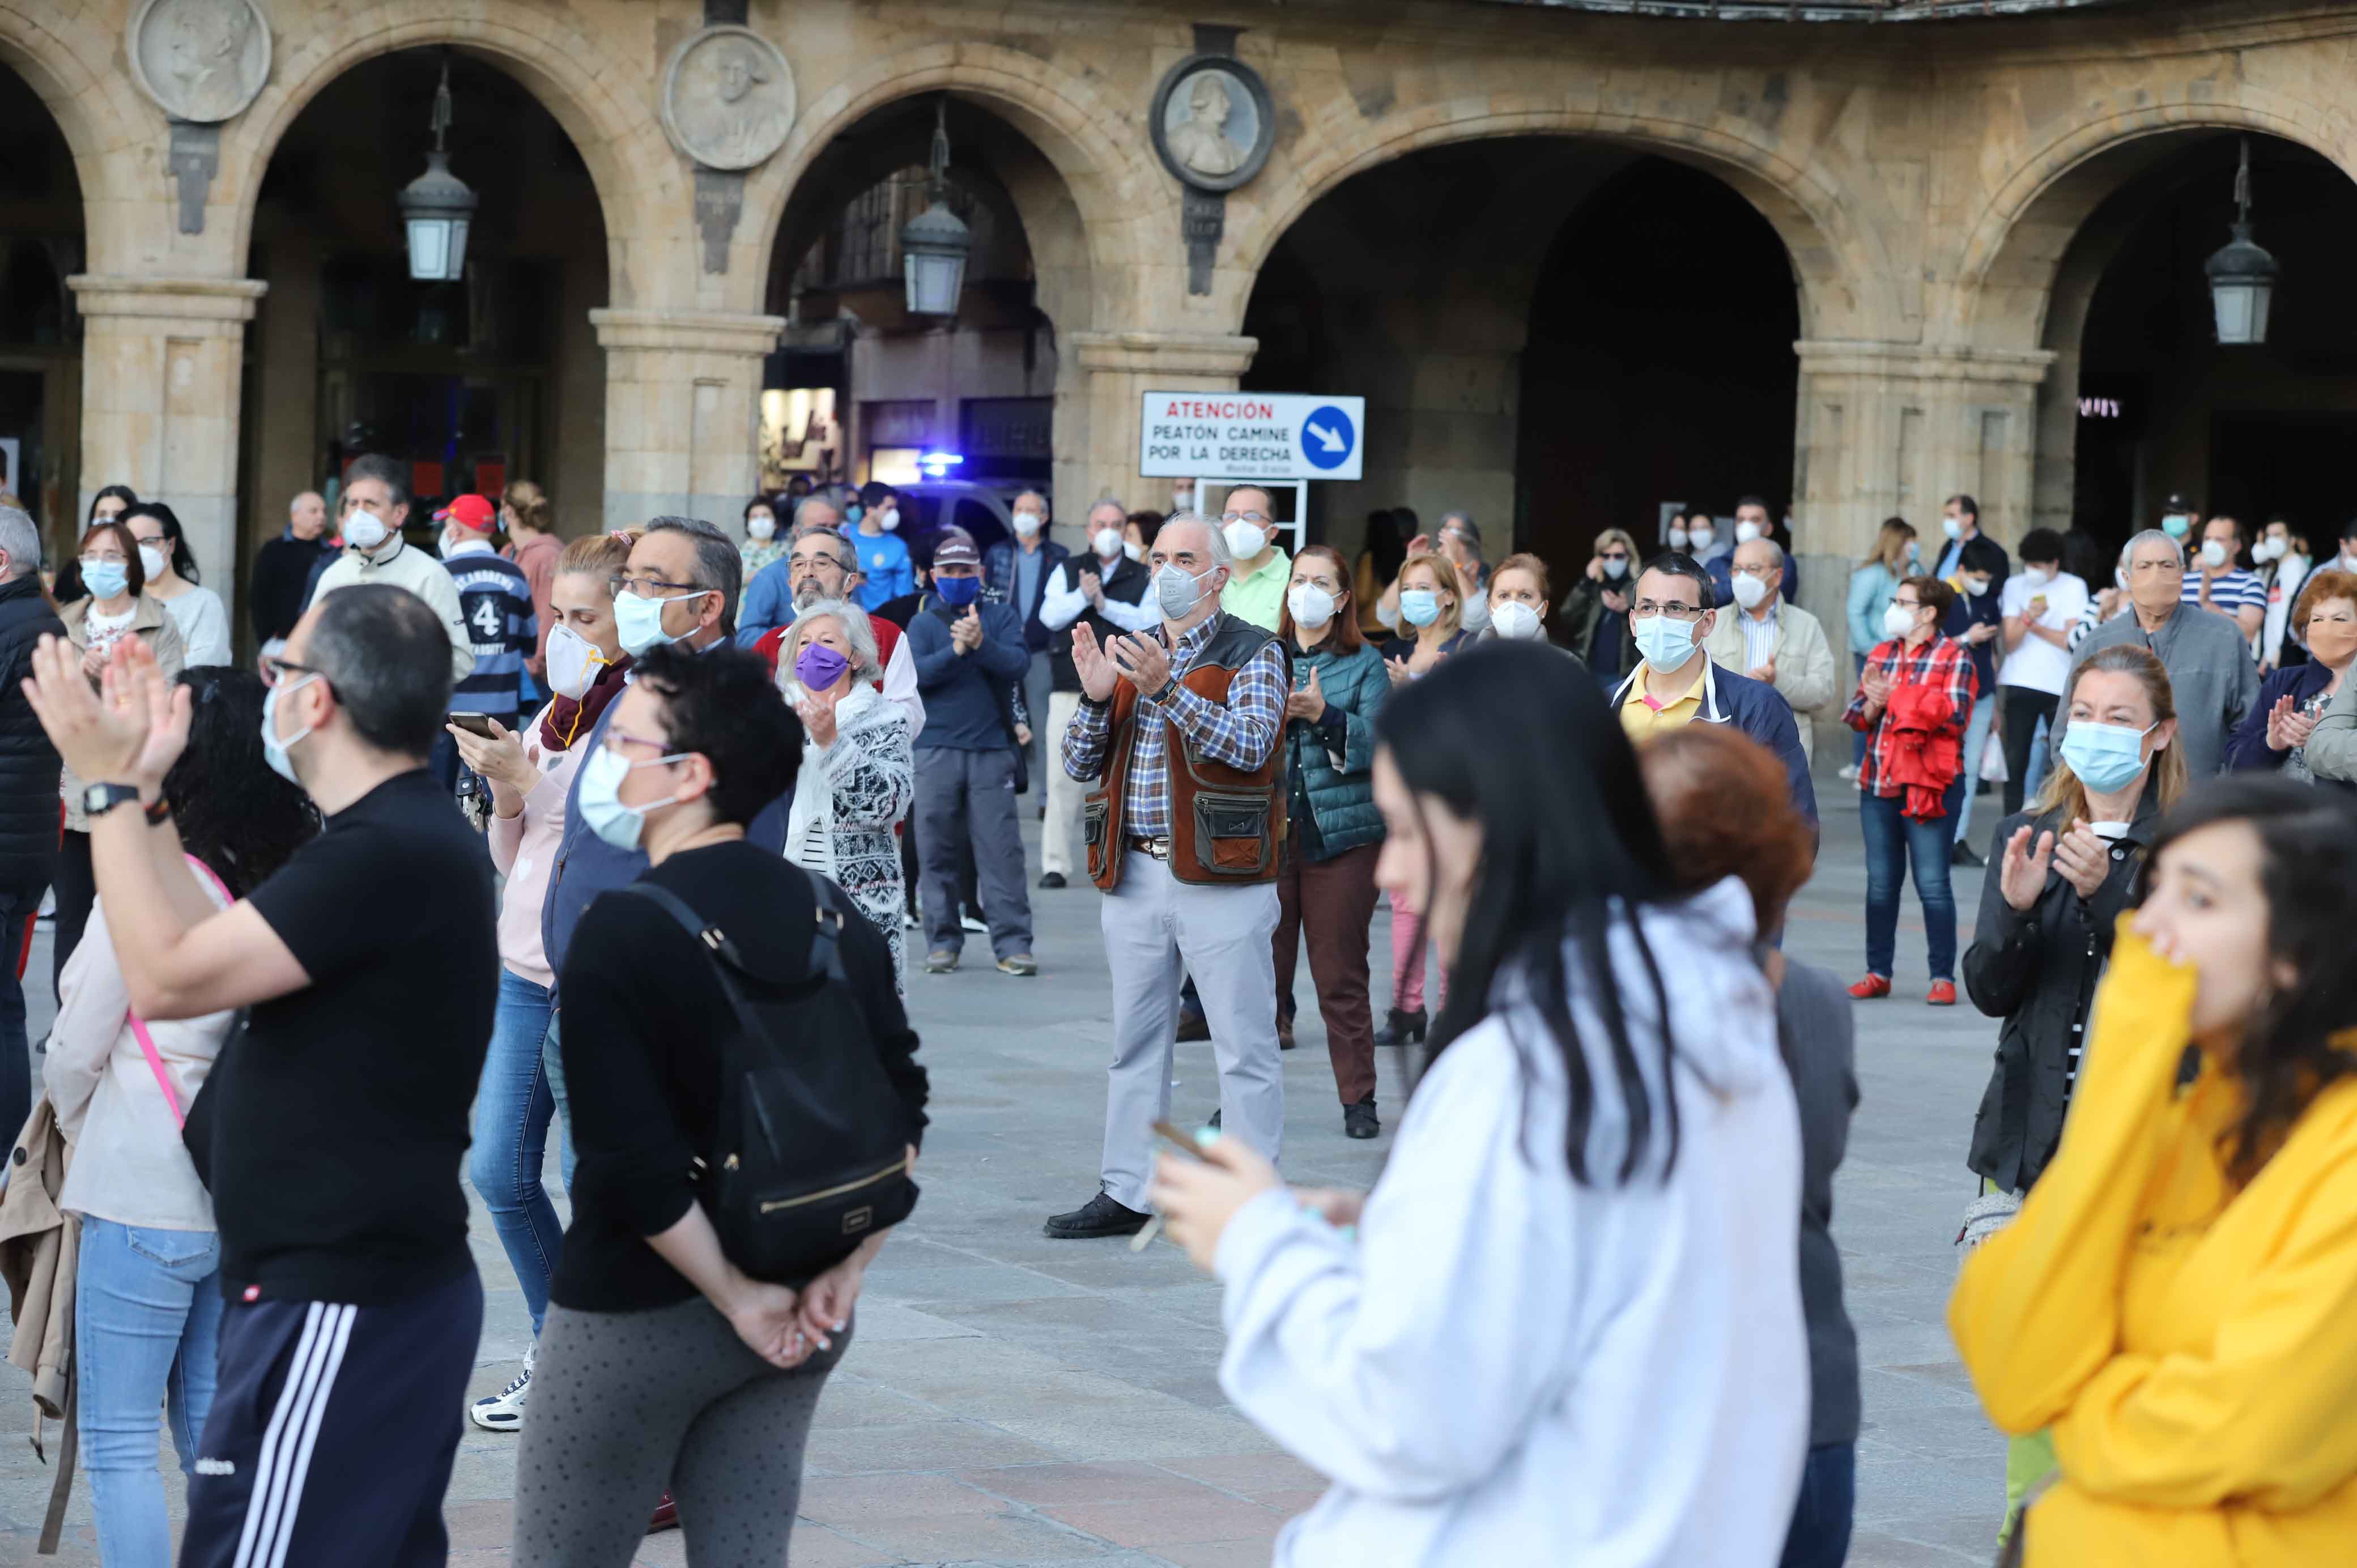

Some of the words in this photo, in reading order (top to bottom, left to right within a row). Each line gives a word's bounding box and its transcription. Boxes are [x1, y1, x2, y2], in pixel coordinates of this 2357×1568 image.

[1166, 400, 1274, 420] ATENCIÓN
[1152, 425, 1218, 441] PEATÓN
[1227, 427, 1290, 442] CAMINE
[1148, 445, 1180, 459] POR
[1190, 446, 1209, 460] LA
[1219, 446, 1291, 461] DERECHA
[473, 599, 500, 636] 4
